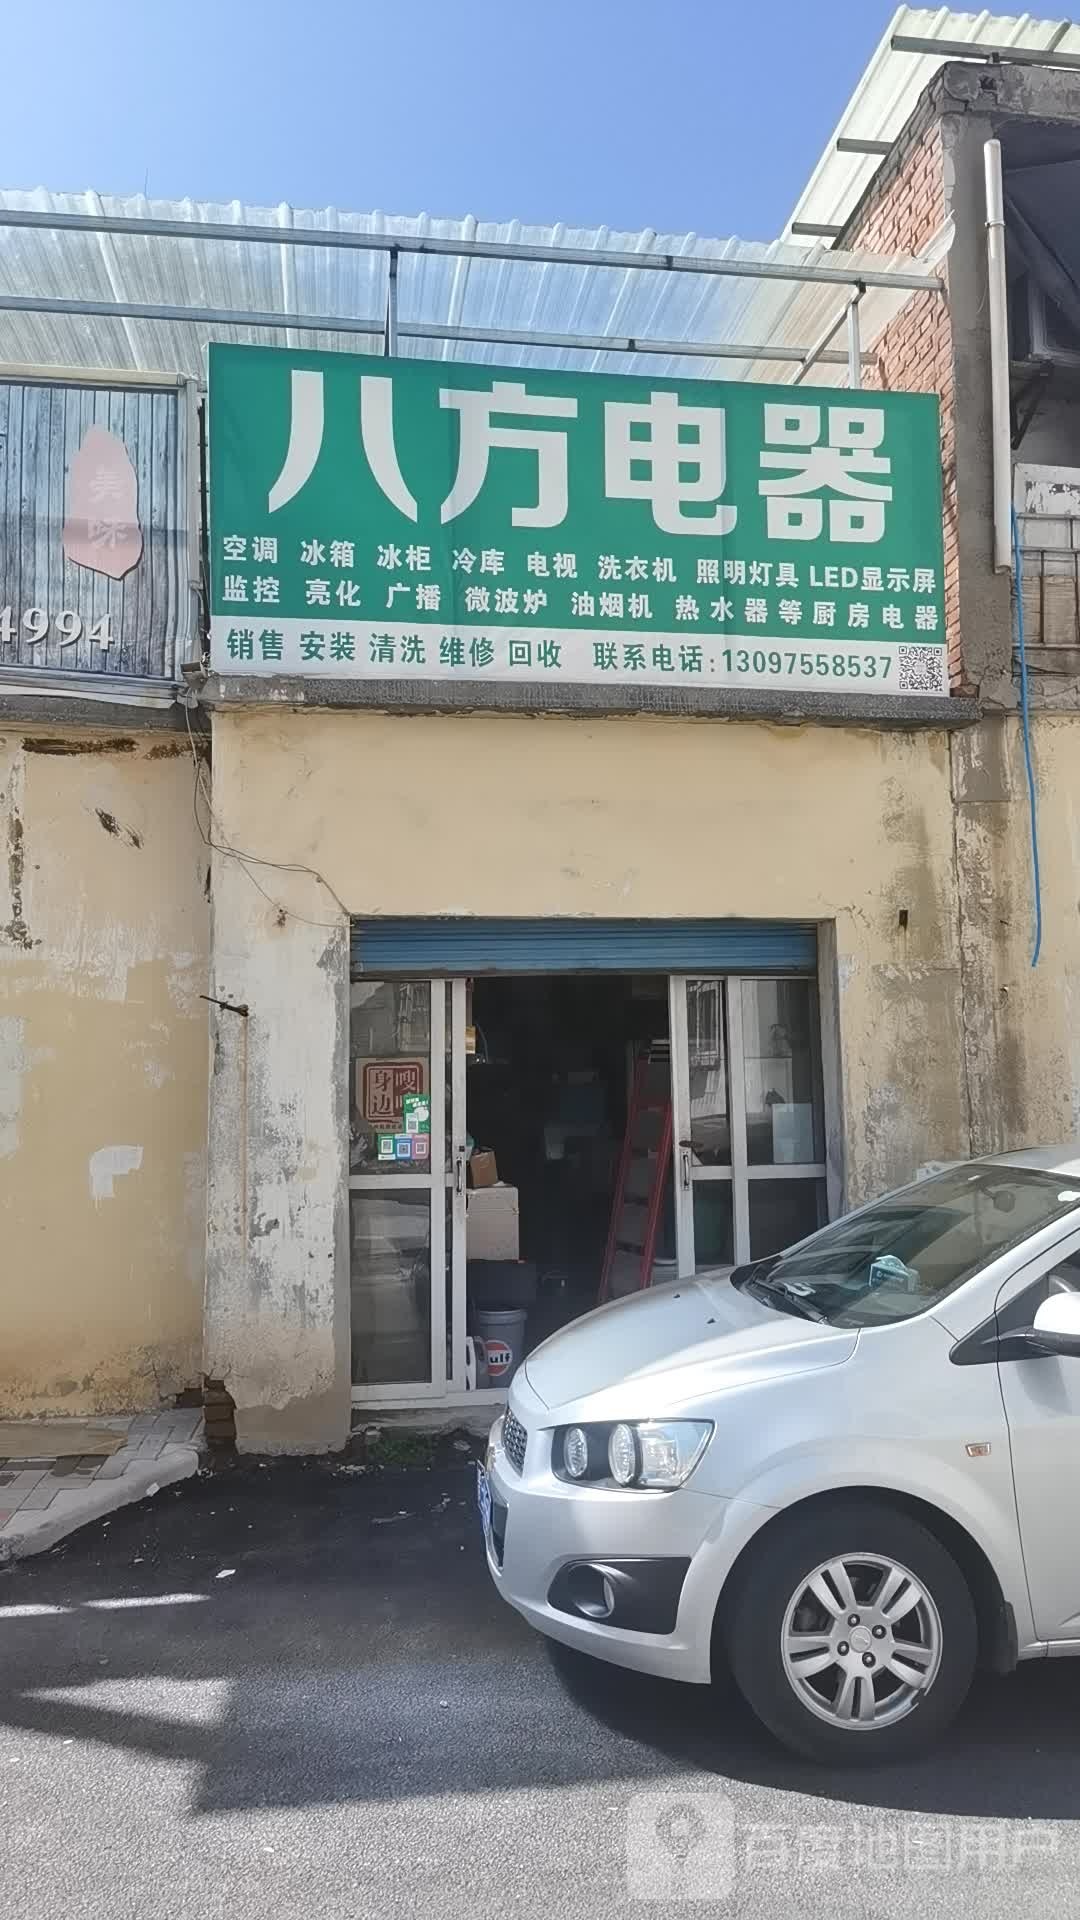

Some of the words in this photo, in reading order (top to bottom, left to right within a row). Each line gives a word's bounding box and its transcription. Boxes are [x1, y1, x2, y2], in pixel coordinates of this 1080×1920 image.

[269, 370, 892, 542] 八方电器
[223, 535, 278, 564] 空调
[300, 539, 355, 568] 冰箱
[377, 543, 432, 571] 冰柜
[452, 547, 505, 576] 冷库
[527, 551, 577, 579] 电视
[598, 555, 677, 583] 洗衣机
[697, 558, 799, 588] 照明灯具
[809, 565, 937, 593] LED显示屏
[222, 575, 280, 604] 监控
[305, 579, 361, 607] 亮化
[386, 583, 441, 611] 广播
[465, 588, 548, 615] 微波炉
[571, 591, 653, 619] 油烟机
[675, 594, 938, 631] 热水器等厨房电器
[227, 628, 284, 661] 销售
[300, 630, 356, 661] 安装
[369, 633, 426, 664] 清洗
[439, 636, 494, 668] 维修
[509, 639, 562, 668] 回收
[372, 1070, 392, 1116] 身边
[488, 1352, 511, 1364] ulf
